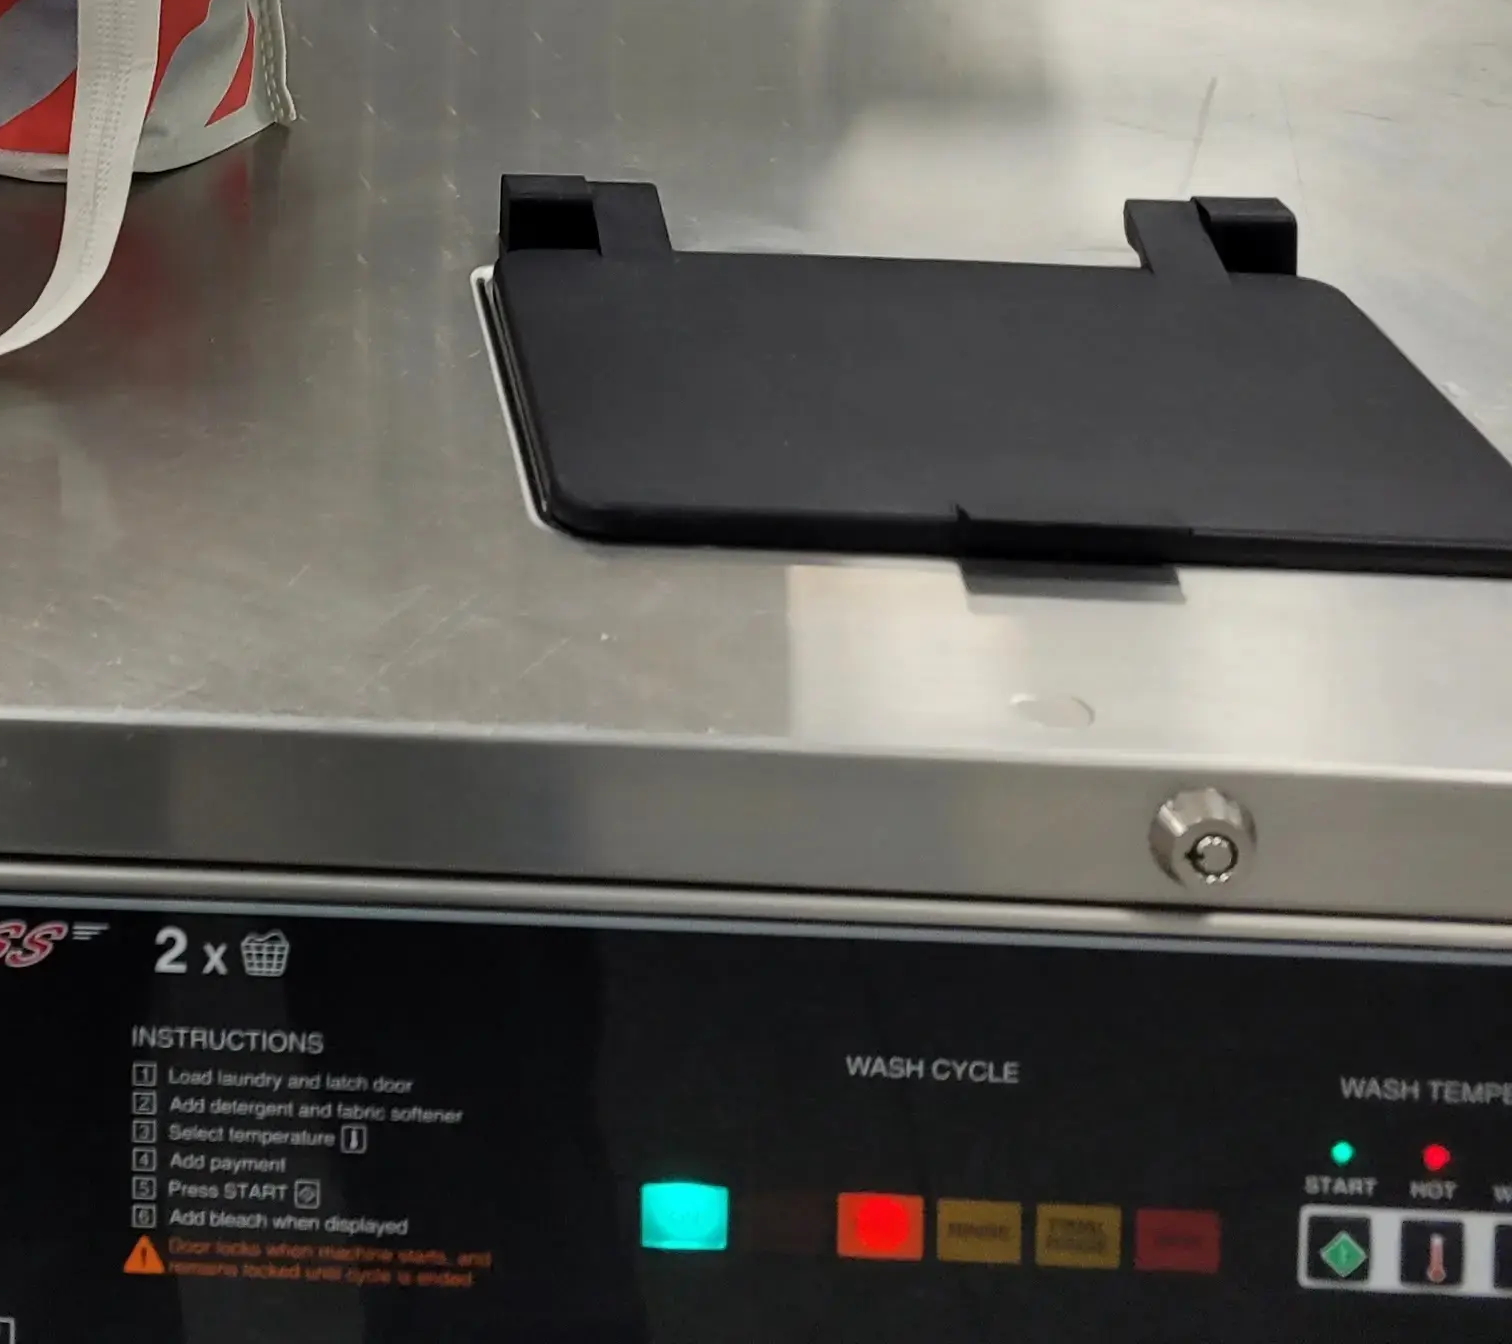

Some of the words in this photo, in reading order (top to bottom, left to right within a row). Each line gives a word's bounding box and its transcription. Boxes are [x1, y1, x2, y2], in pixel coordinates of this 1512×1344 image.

[153, 926, 188, 975] 2
[201, 942, 229, 976] x
[131, 1025, 325, 1055] INSTRUCTIONS
[168, 1068, 212, 1087] Load
[217, 1070, 283, 1092] laundry
[288, 1072, 320, 1091] and
[326, 1073, 369, 1092] latch
[372, 1074, 414, 1094] door
[844, 1055, 925, 1081] WASH
[931, 1057, 1021, 1084] CYCLE
[1339, 1076, 1420, 1101] WASH
[169, 1096, 206, 1114] Add
[210, 1098, 294, 1120] detergent
[298, 1101, 332, 1120] and
[336, 1102, 386, 1122] fabric
[390, 1105, 464, 1125] softener
[168, 1123, 224, 1143] Select
[229, 1126, 336, 1148] temperature
[169, 1152, 206, 1171] Add
[210, 1155, 287, 1175] payment
[168, 1180, 219, 1199] Press
[224, 1182, 289, 1201] START
[1303, 1174, 1379, 1196] START
[1409, 1180, 1459, 1200] HOT
[169, 1209, 206, 1228] Add
[210, 1211, 268, 1230] bleach
[272, 1214, 320, 1233] when
[324, 1215, 409, 1238] displayed
